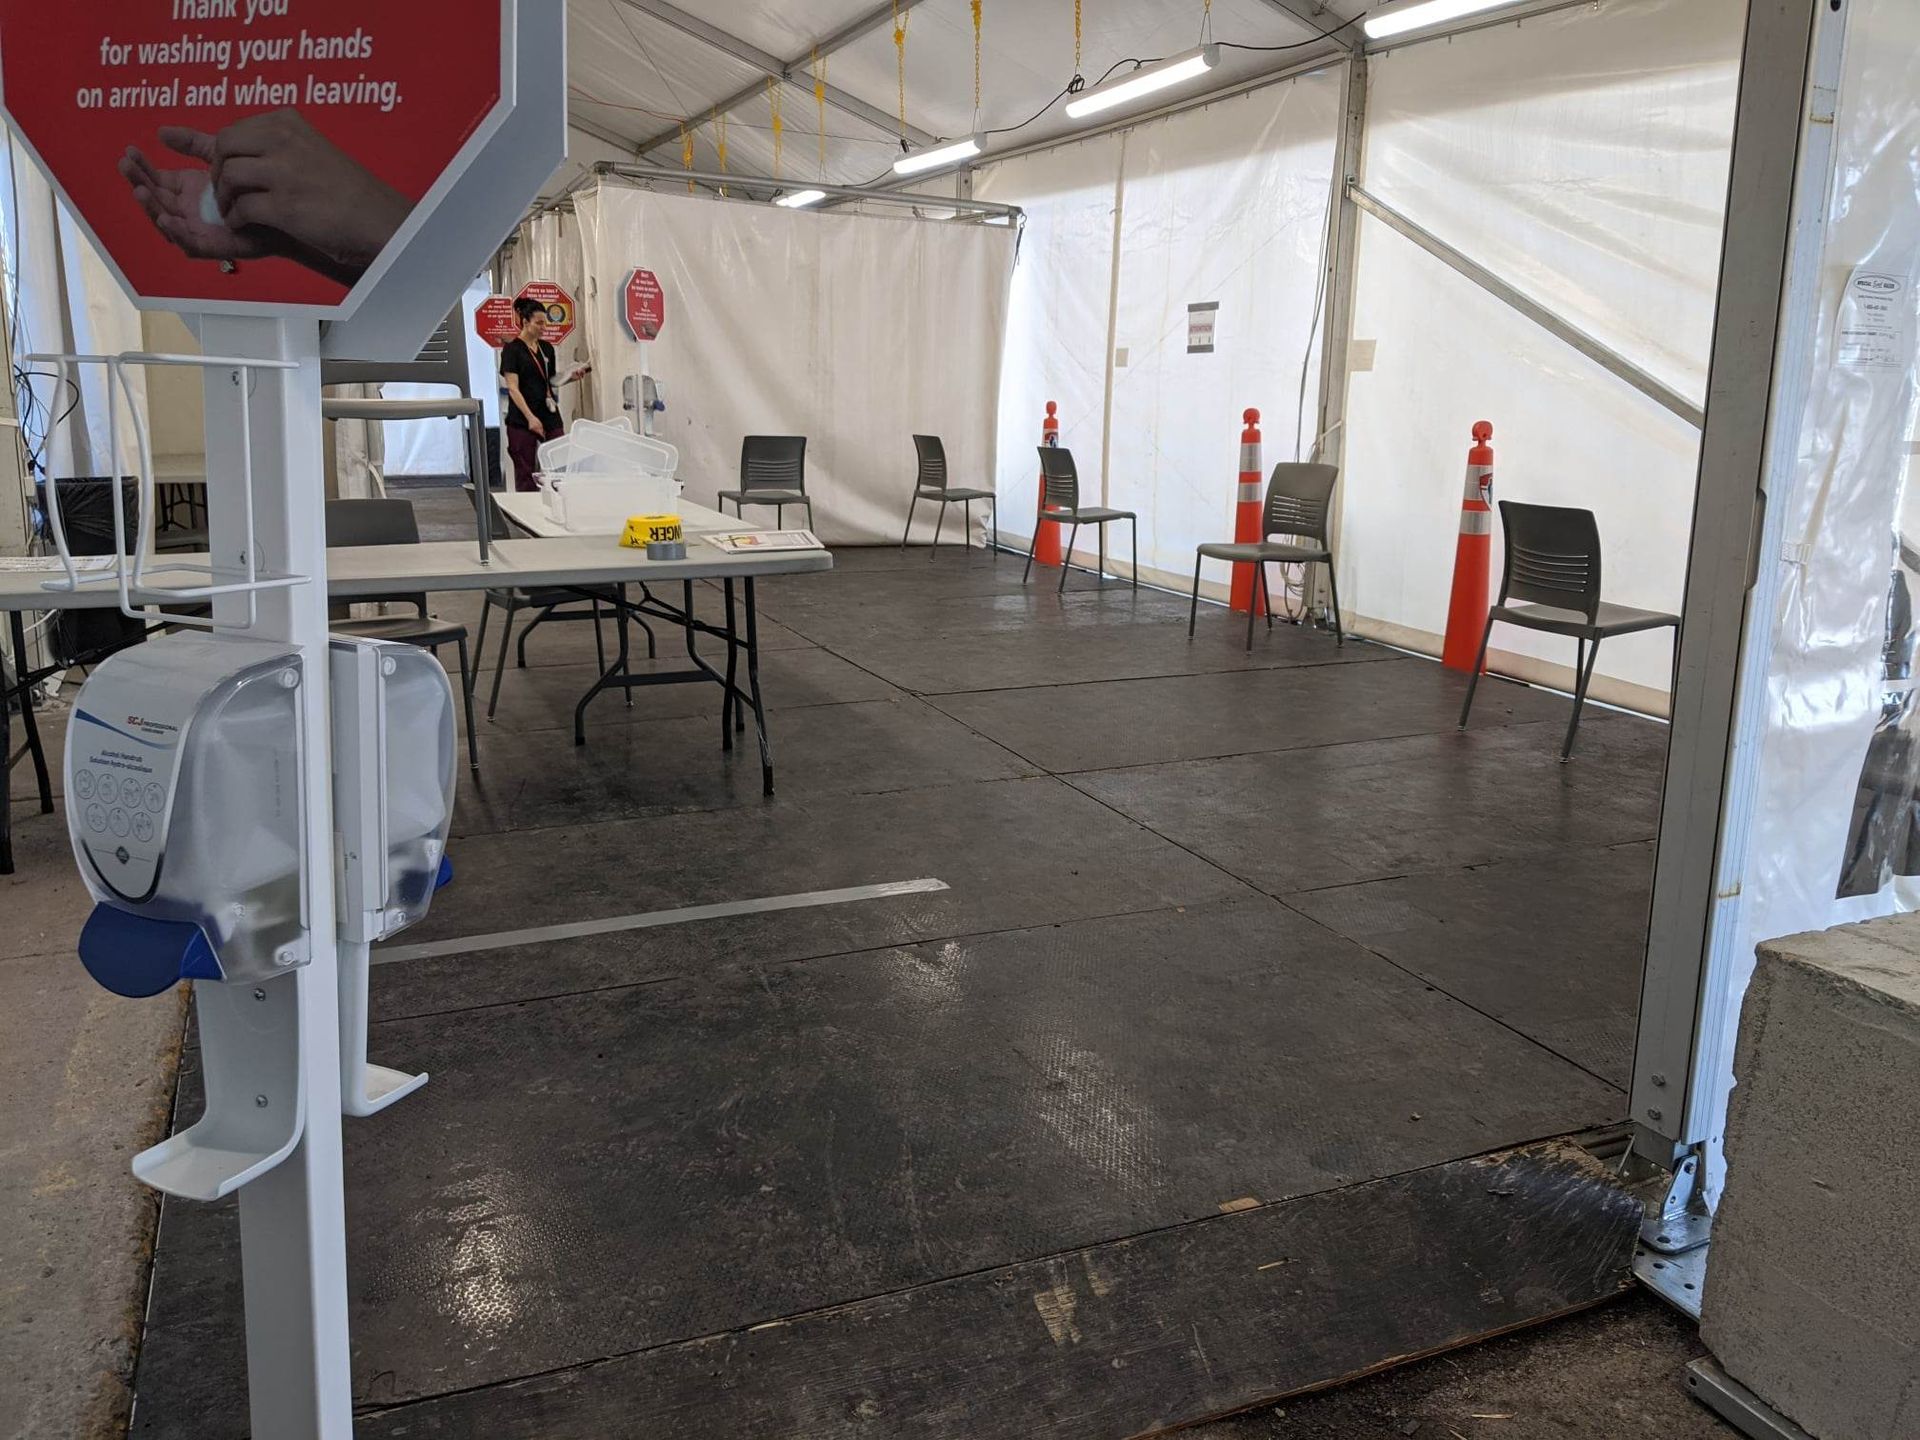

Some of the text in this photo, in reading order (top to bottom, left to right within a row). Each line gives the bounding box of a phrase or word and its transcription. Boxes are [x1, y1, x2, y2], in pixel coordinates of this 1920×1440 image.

[172, 0, 288, 25] Thank you
[100, 27, 373, 70] for washing your hands
[77, 73, 403, 112] on arrival and when leaving.
